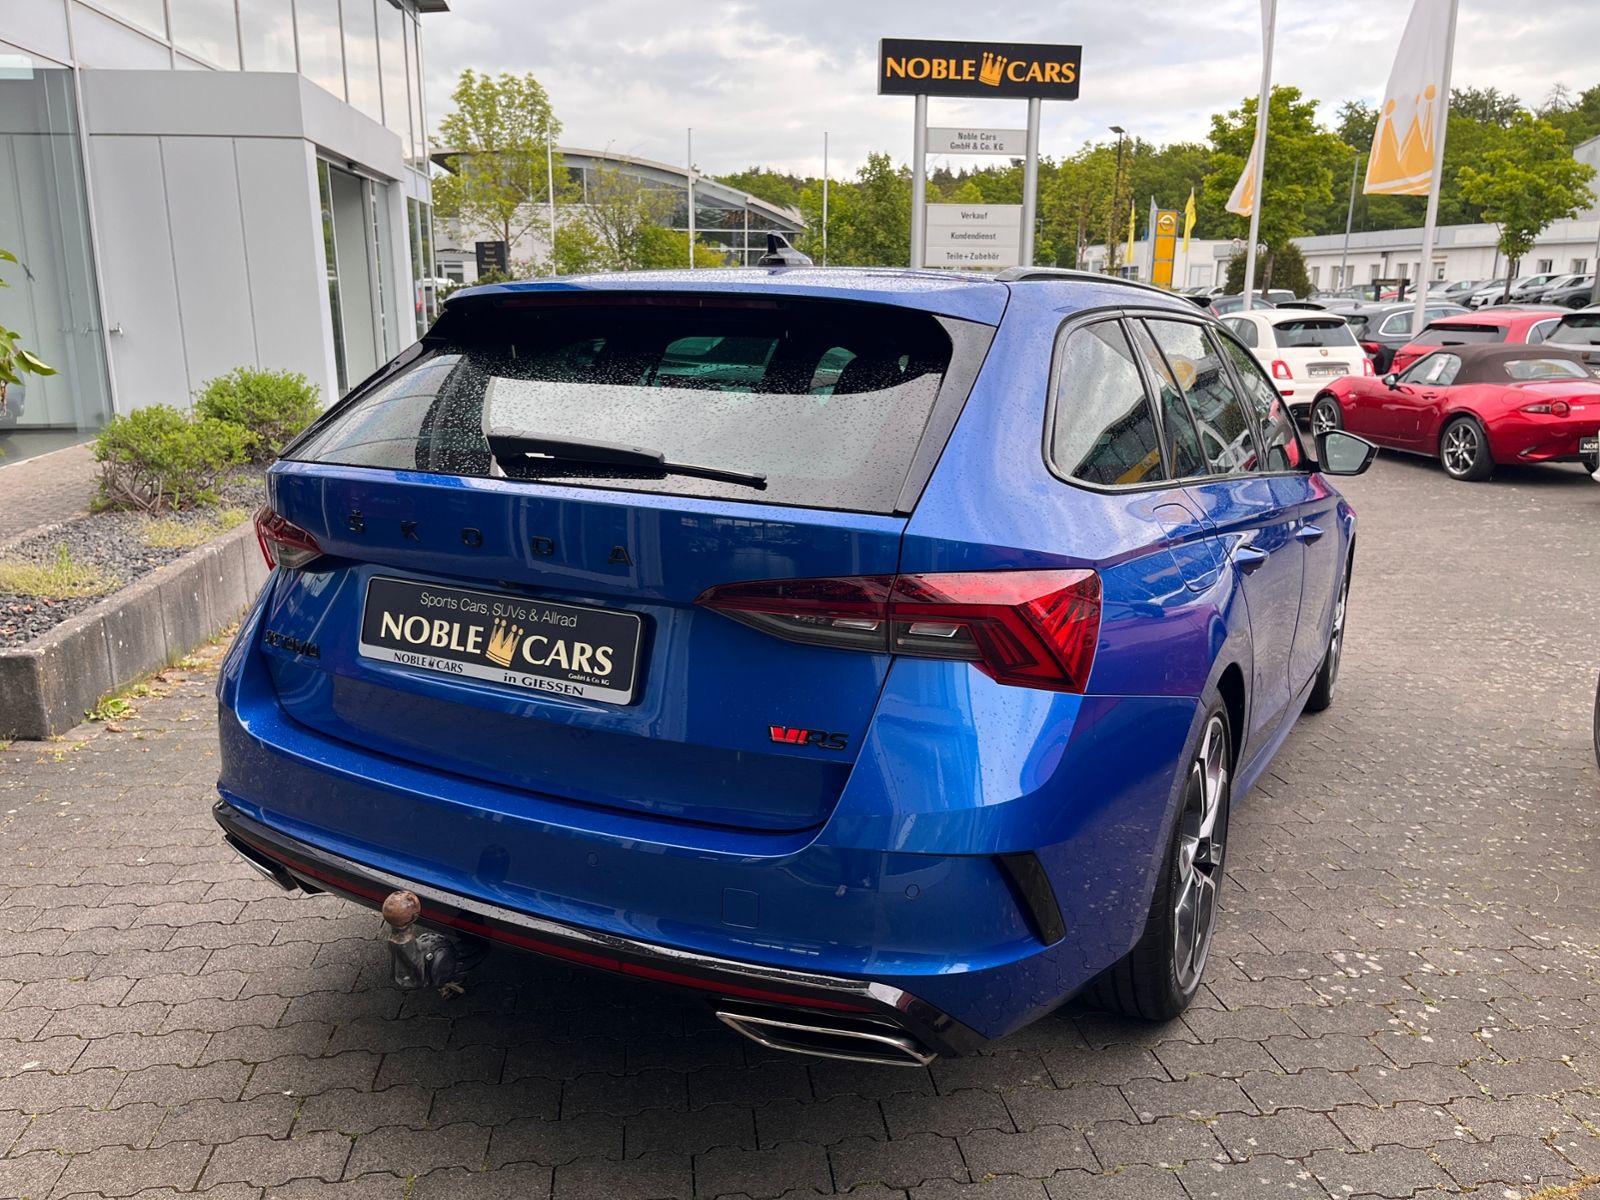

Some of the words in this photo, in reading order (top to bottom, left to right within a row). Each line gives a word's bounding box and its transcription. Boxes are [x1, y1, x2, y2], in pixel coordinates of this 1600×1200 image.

[886, 57, 976, 80] NOBLE
[1007, 61, 1076, 84] CARS
[958, 132, 978, 140] Noble
[980, 132, 996, 141] Cars
[950, 142, 971, 150] GmbH
[972, 142, 978, 150] &
[993, 143, 1004, 151] KG
[960, 211, 988, 220] Verkauf
[950, 231, 996, 240] Kundendienst
[420, 592, 458, 609] Sports
[460, 598, 490, 616] Cars,
[492, 602, 526, 620] SUVs
[528, 608, 539, 622] &
[541, 611, 578, 628] Allrad
[380, 611, 485, 655] NOBLE
[522, 635, 613, 676] CARS
[394, 652, 428, 667] NOBLE
[436, 659, 464, 674] CARS
[503, 672, 517, 684] in
[521, 675, 585, 696] GIESSEN
[568, 672, 586, 681] GmbH
